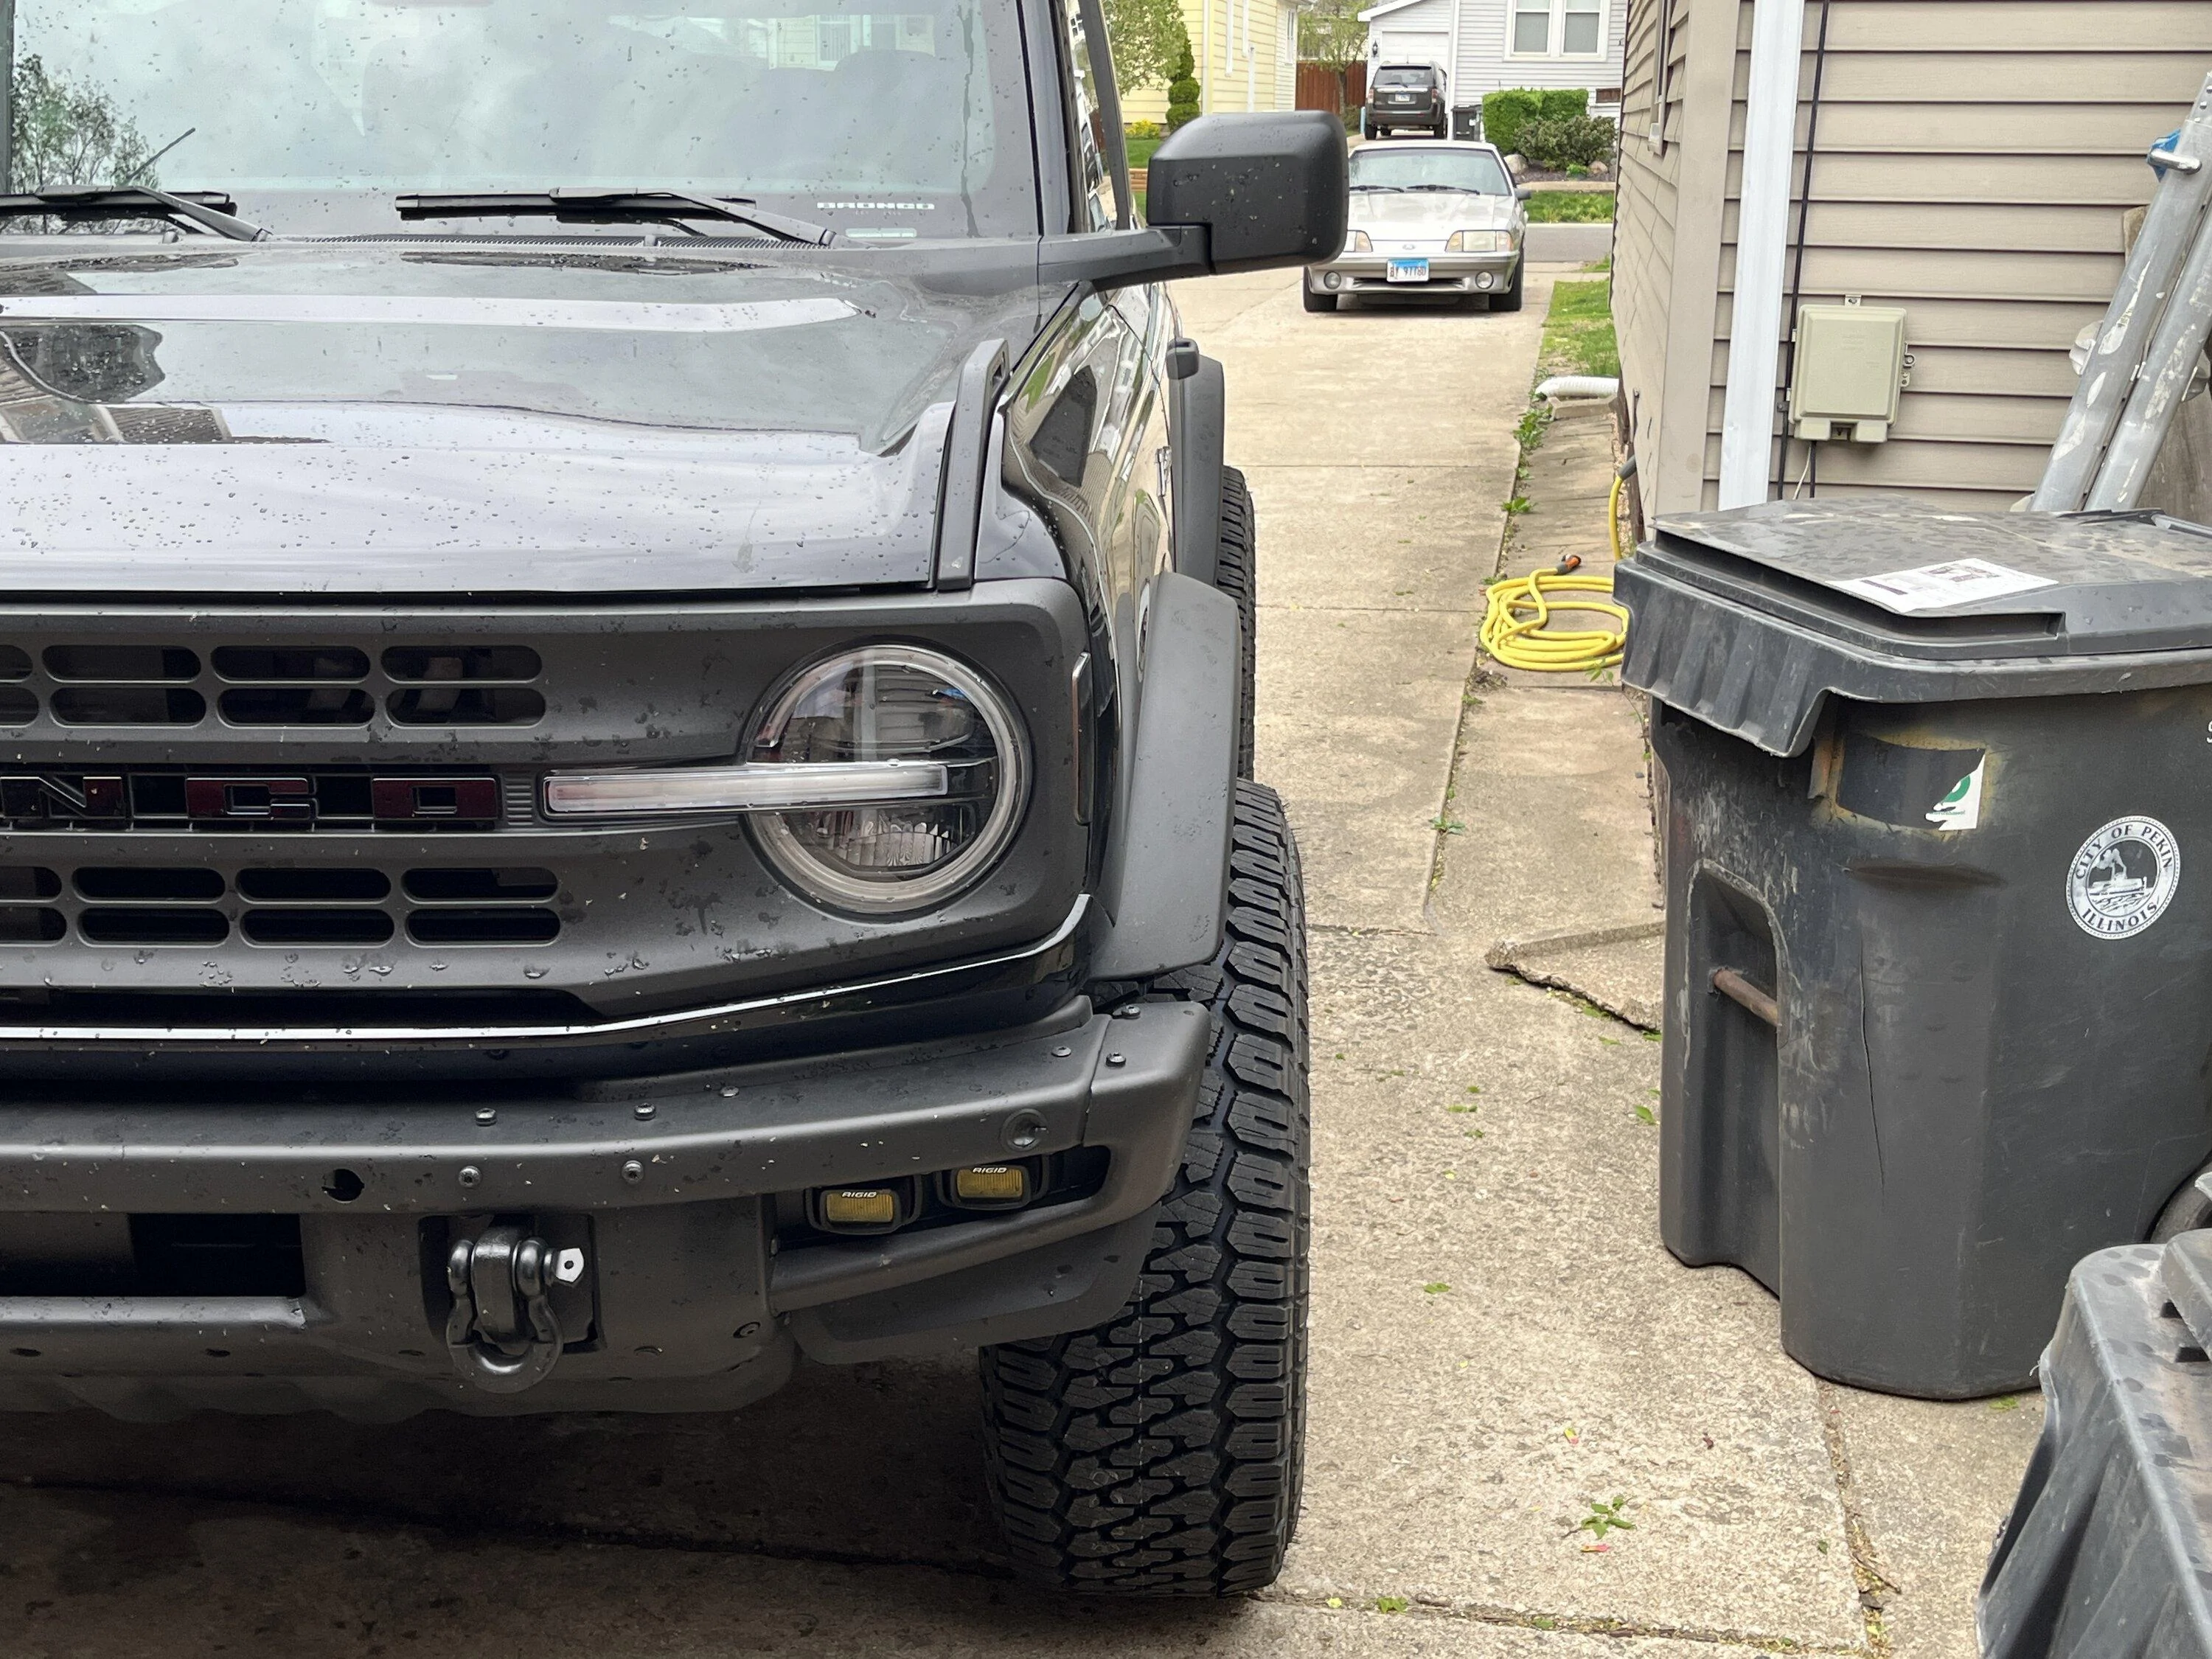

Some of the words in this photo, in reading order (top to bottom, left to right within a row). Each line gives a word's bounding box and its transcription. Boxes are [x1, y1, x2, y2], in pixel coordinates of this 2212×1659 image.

[2076, 838, 2102, 880] CITY
[2111, 824, 2134, 838] OF
[2141, 826, 2173, 869] PEKIN
[2082, 901, 2157, 931] ILLINOIS
